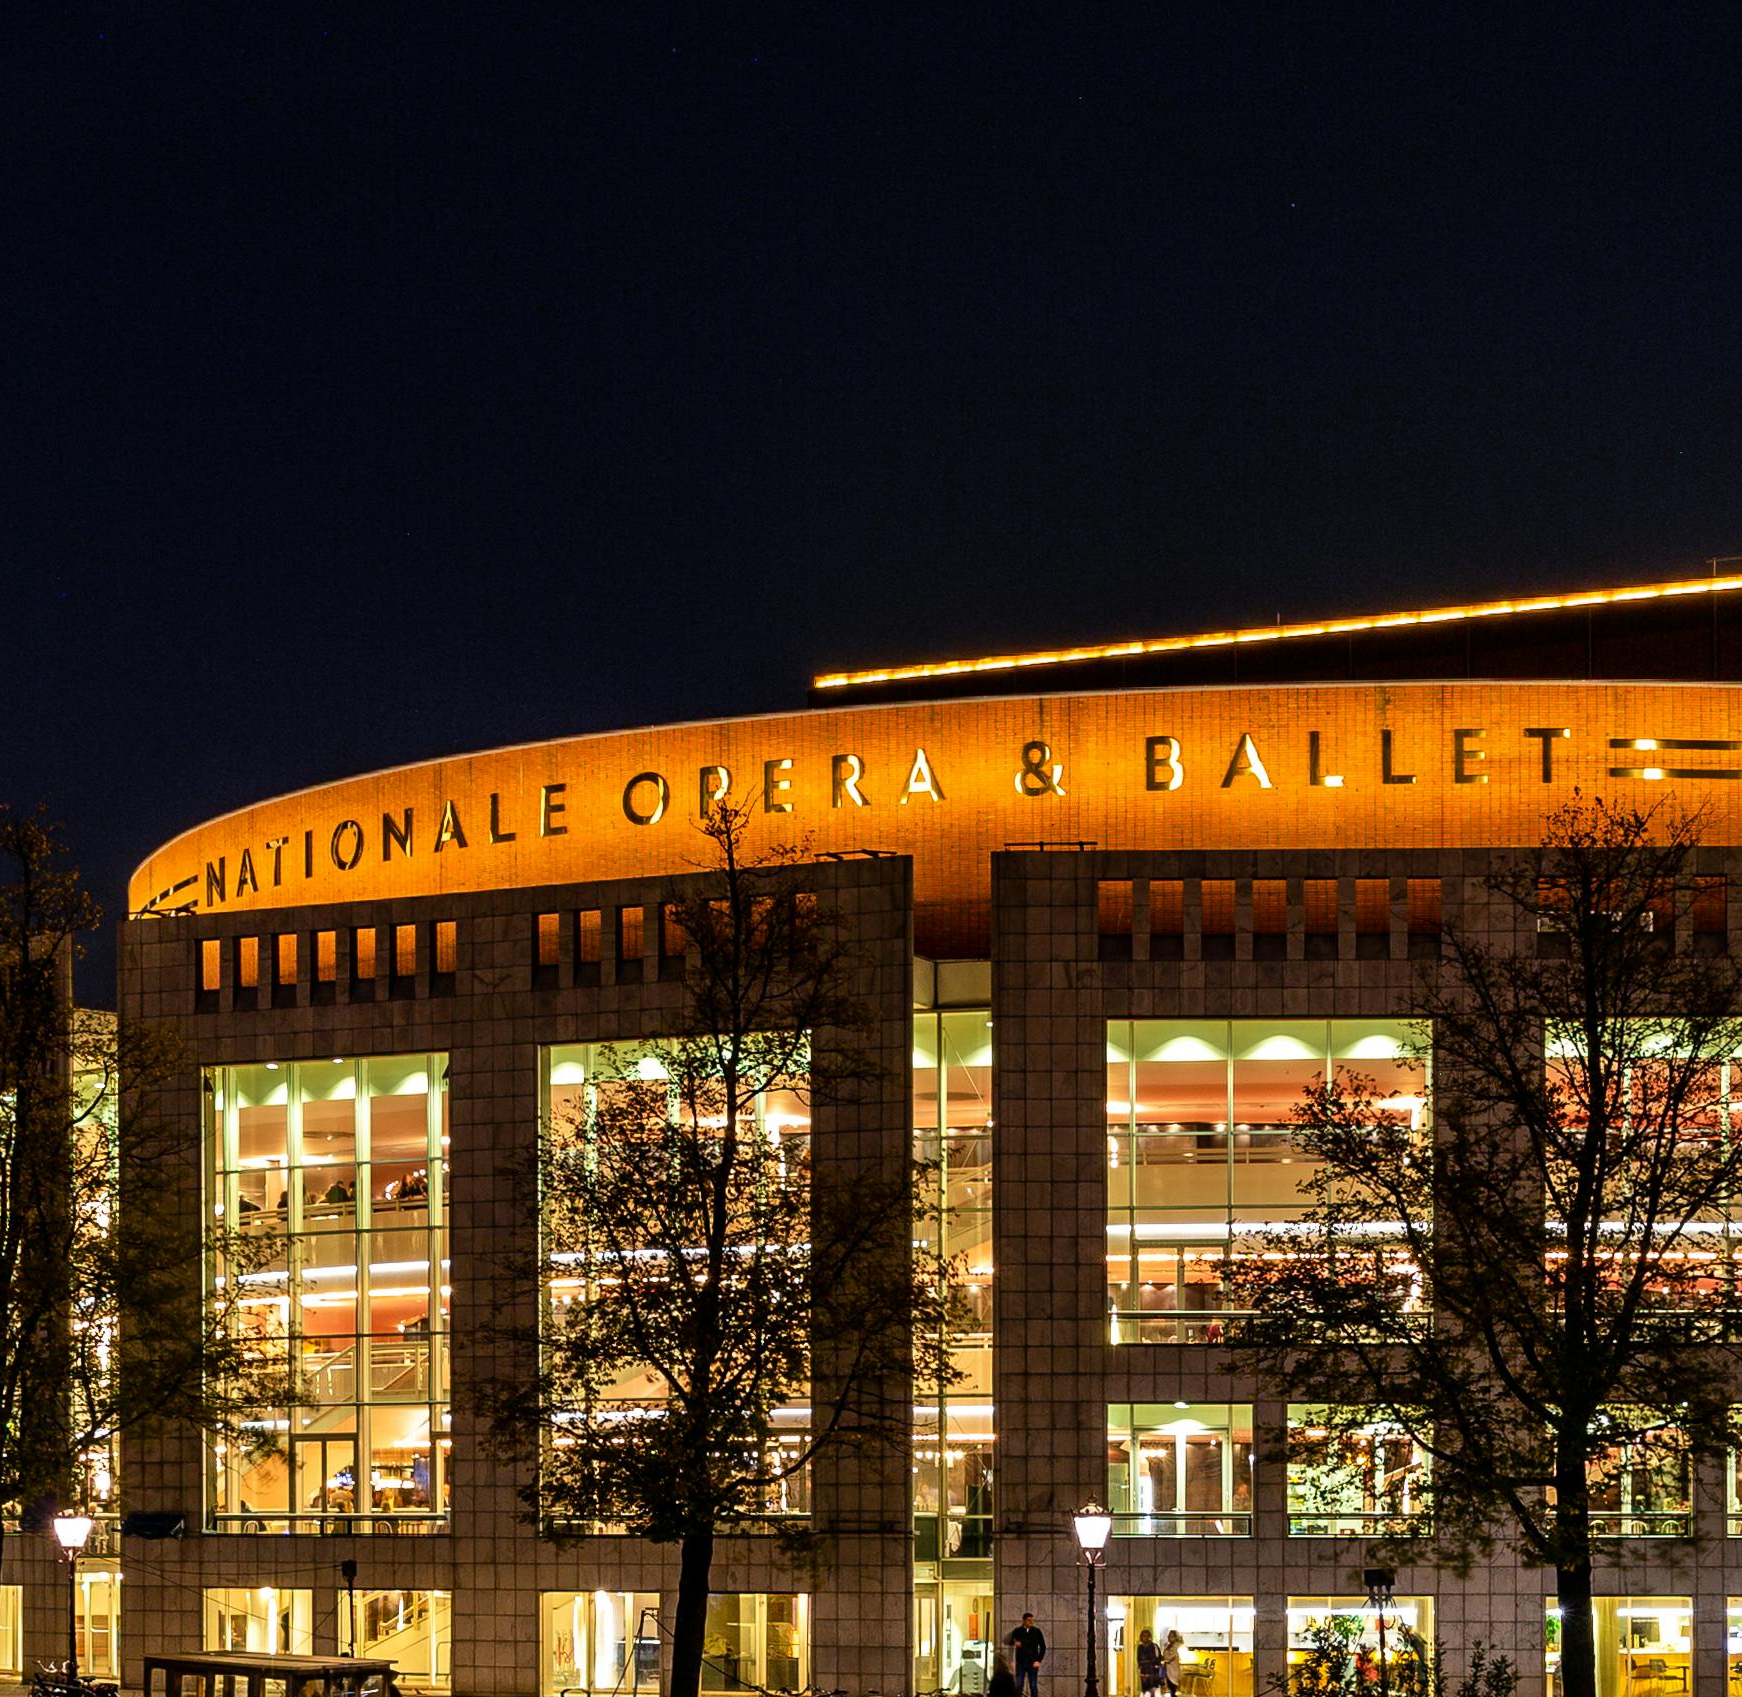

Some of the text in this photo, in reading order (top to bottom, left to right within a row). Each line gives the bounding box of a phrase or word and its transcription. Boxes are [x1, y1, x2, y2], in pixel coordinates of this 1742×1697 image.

[205, 727, 1572, 907] NATIONALE OPERA & BALLET
